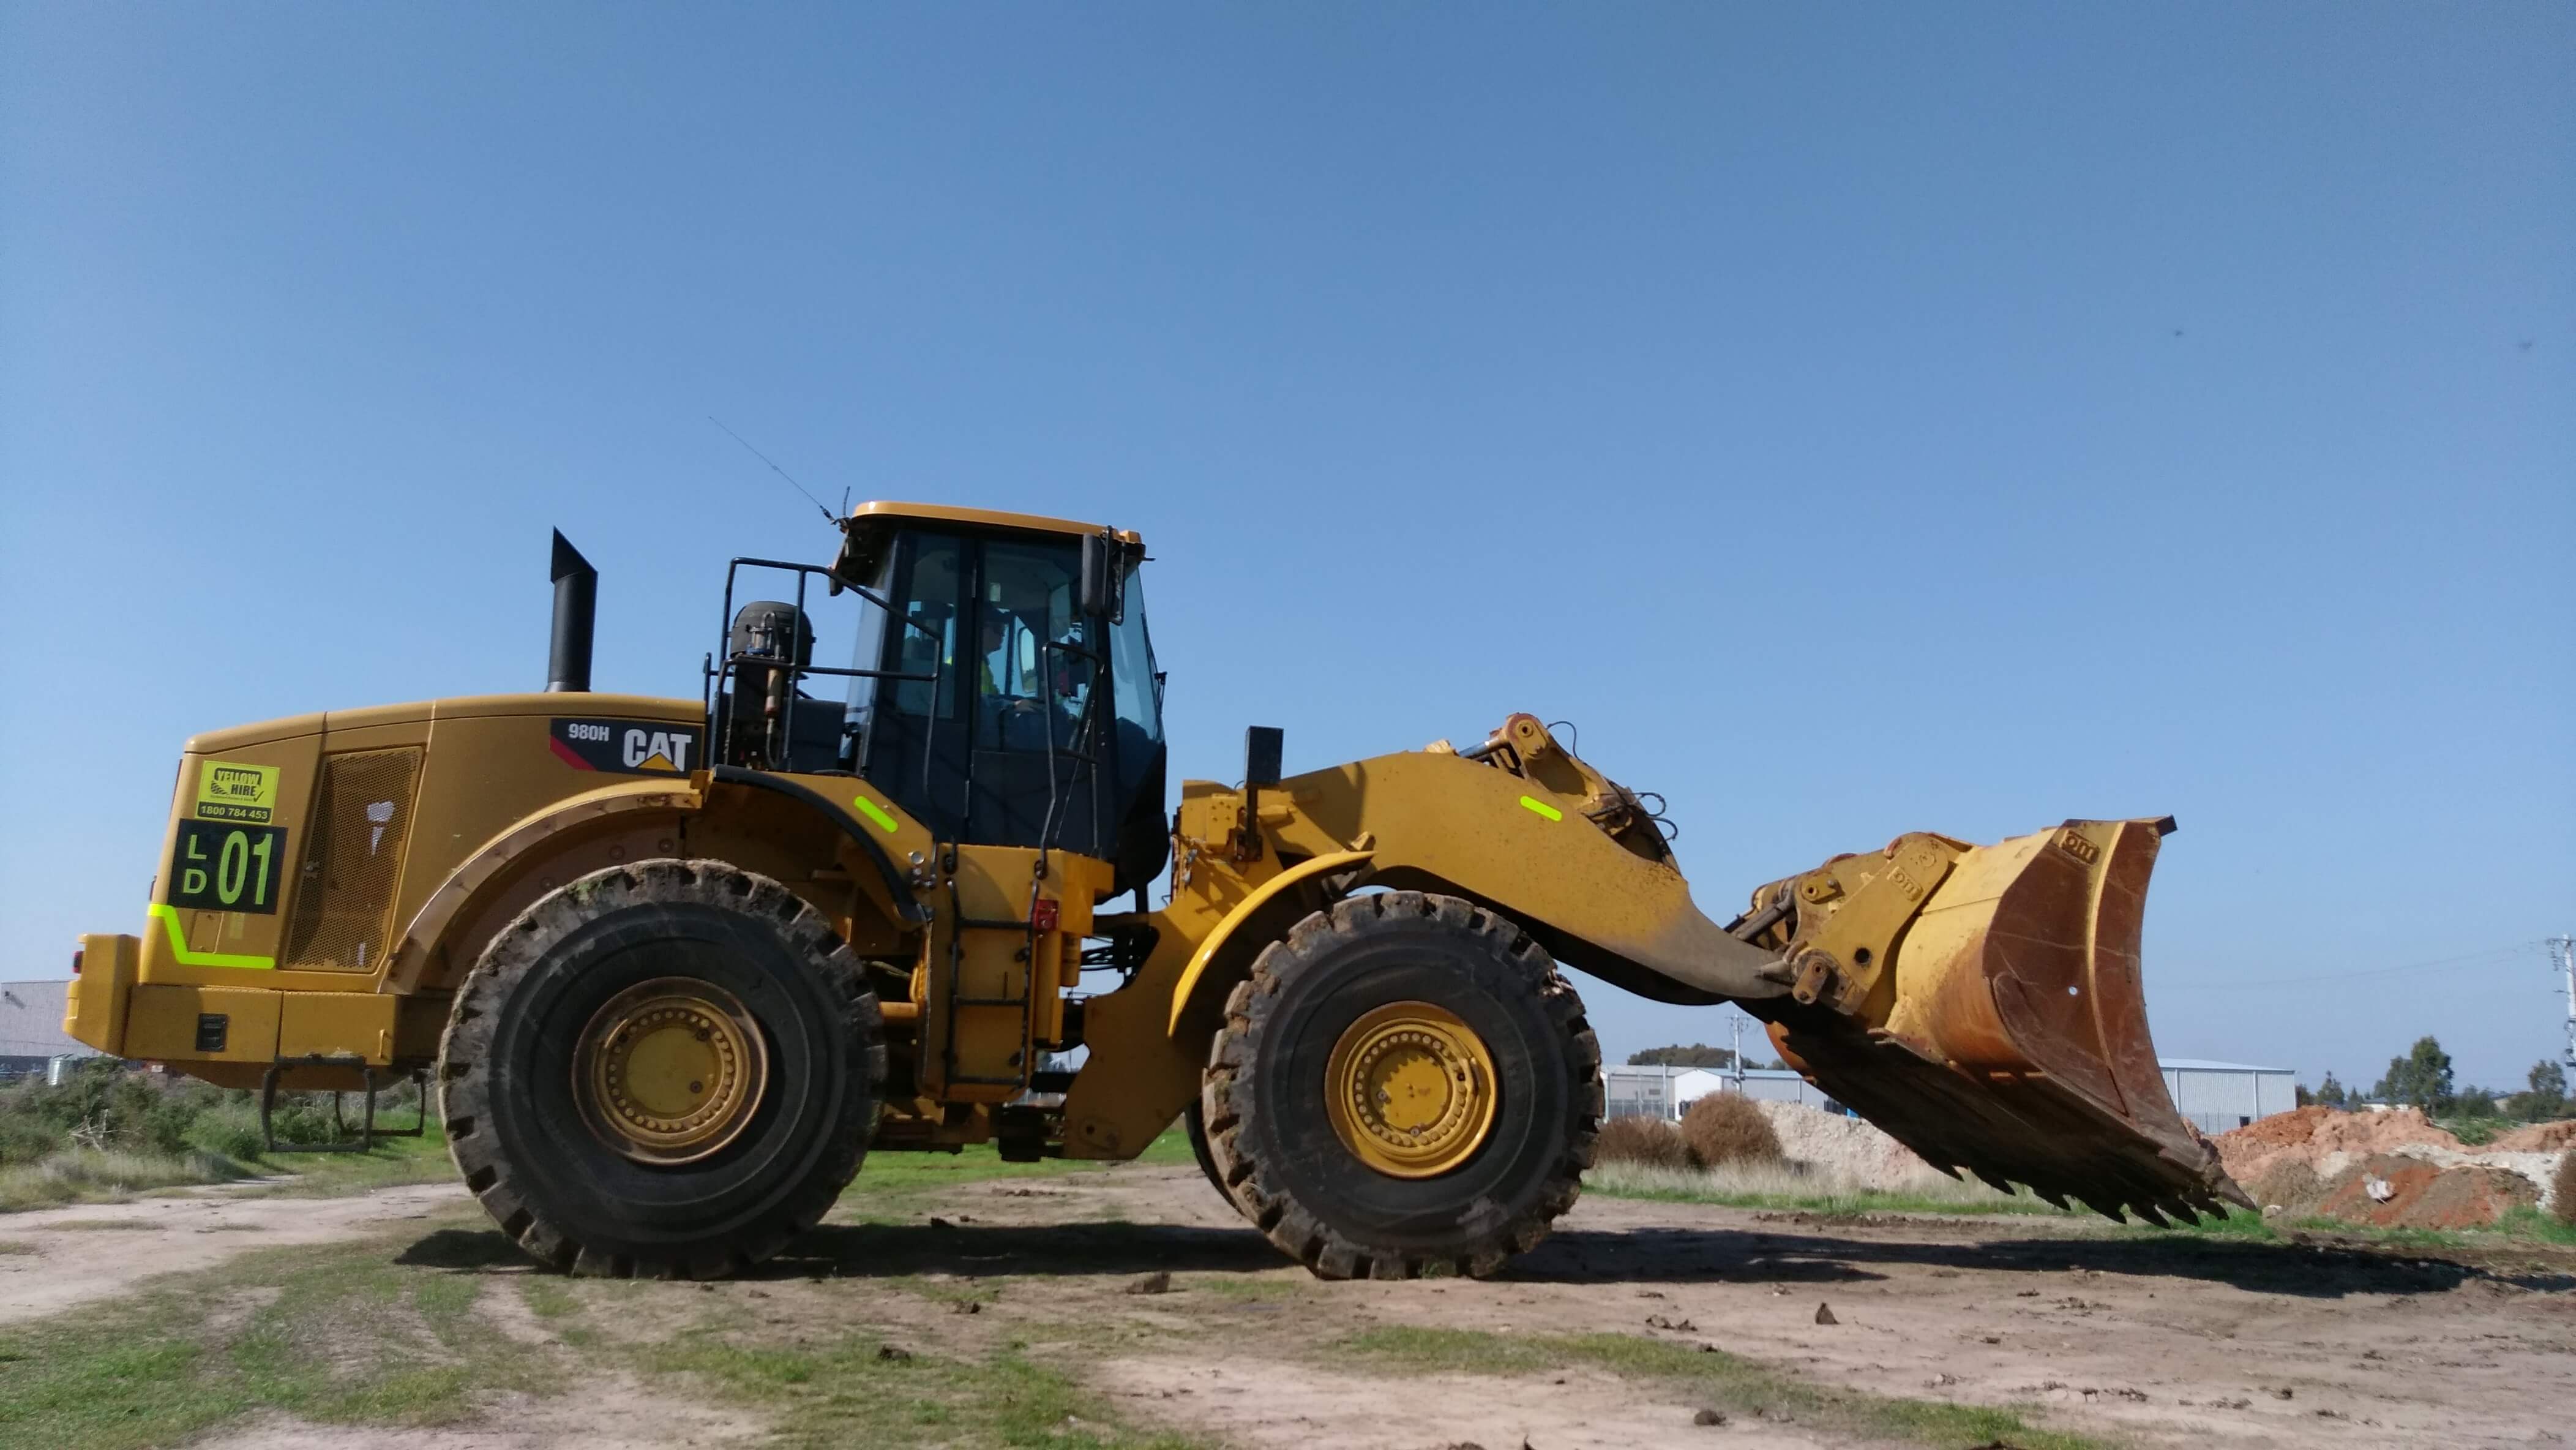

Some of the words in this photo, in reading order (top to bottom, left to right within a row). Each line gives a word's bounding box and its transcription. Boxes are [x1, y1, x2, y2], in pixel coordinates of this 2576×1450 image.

[568, 723, 610, 742] 980H
[623, 729, 692, 772] CAT
[217, 770, 260, 785] YELLOW
[231, 784, 256, 796] HIRE
[201, 805, 225, 815] 1800
[228, 808, 246, 817] 784
[249, 810, 268, 819] 453
[219, 830, 273, 905] 01
